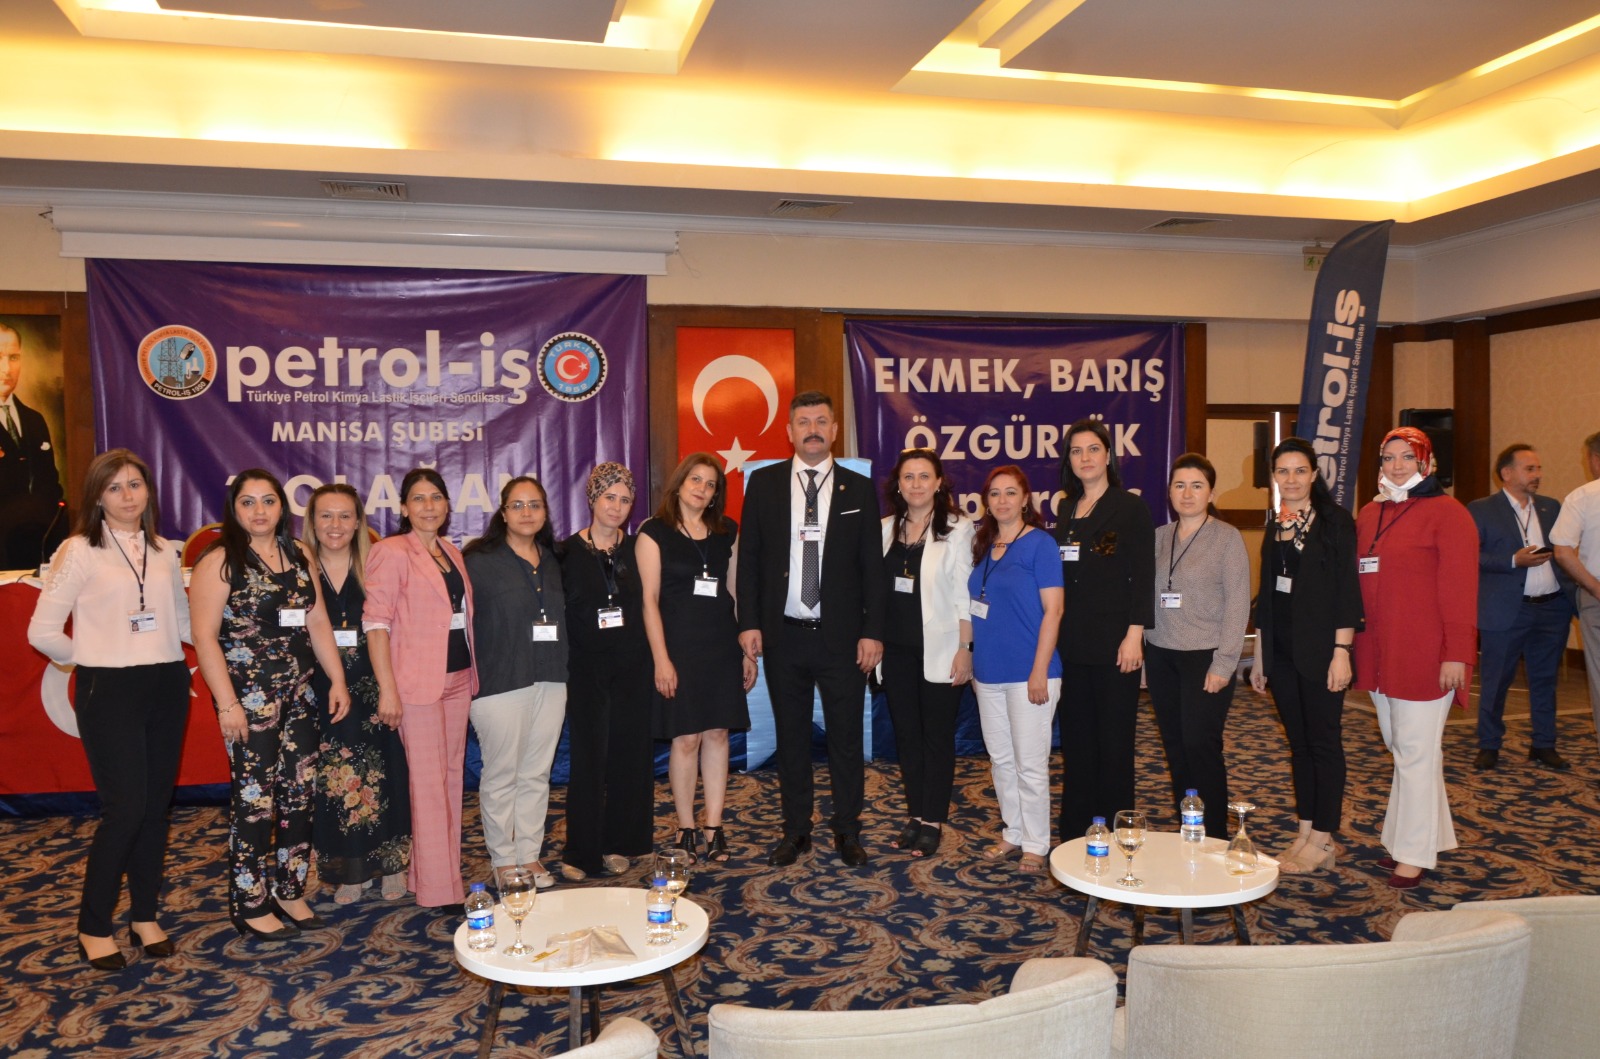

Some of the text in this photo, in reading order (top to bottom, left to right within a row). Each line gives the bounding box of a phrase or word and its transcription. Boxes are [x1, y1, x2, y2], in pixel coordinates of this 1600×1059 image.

[226, 329, 532, 405] petrol-iş
[874, 357, 1165, 402] EKMEK, BARIŞ
[246, 390, 291, 405] Türkiye
[294, 391, 329, 403] Petrol
[332, 391, 369, 405] Kimya
[371, 391, 406, 403] Lastik
[1312, 289, 1366, 492] etrol-iş
[1343, 399, 1355, 425] Lastik
[904, 413, 1142, 461] ÖZGÜRK
[1340, 428, 1352, 454] Kimya
[1337, 456, 1347, 482] Petrol
[1335, 483, 1345, 506] rkiye
